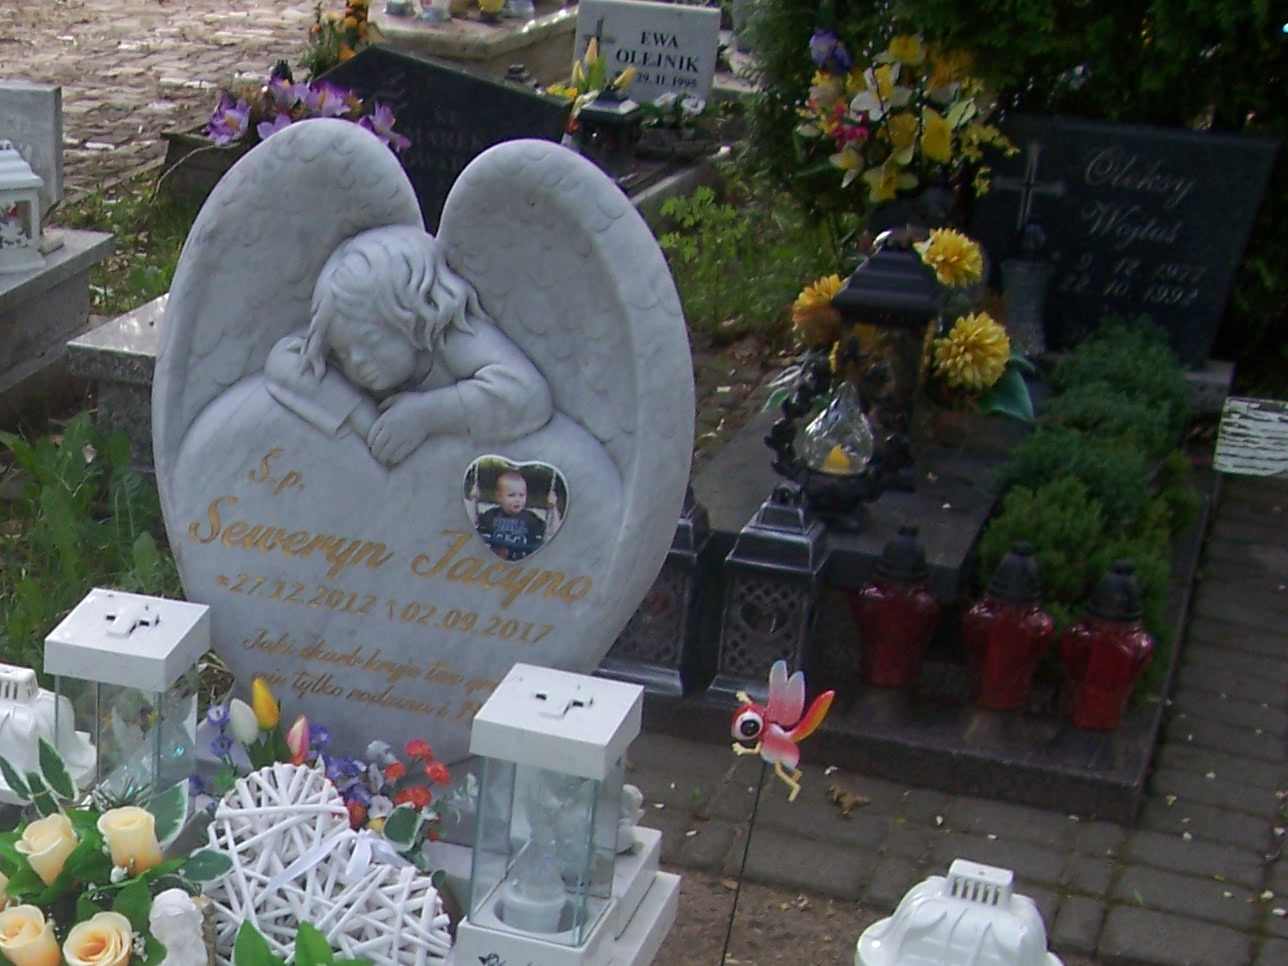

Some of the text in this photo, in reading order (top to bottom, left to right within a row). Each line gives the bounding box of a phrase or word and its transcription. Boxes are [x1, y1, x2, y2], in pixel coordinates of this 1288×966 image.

[640, 31, 679, 49] EWA
[615, 48, 700, 74] OLEJNIK
[189, 495, 593, 609] Seweryn Jacyno
[400, 601, 553, 645] 02.09.2017
[242, 627, 294, 657] Jaki
[300, 639, 362, 667] skarb
[291, 671, 344, 700] tylko
